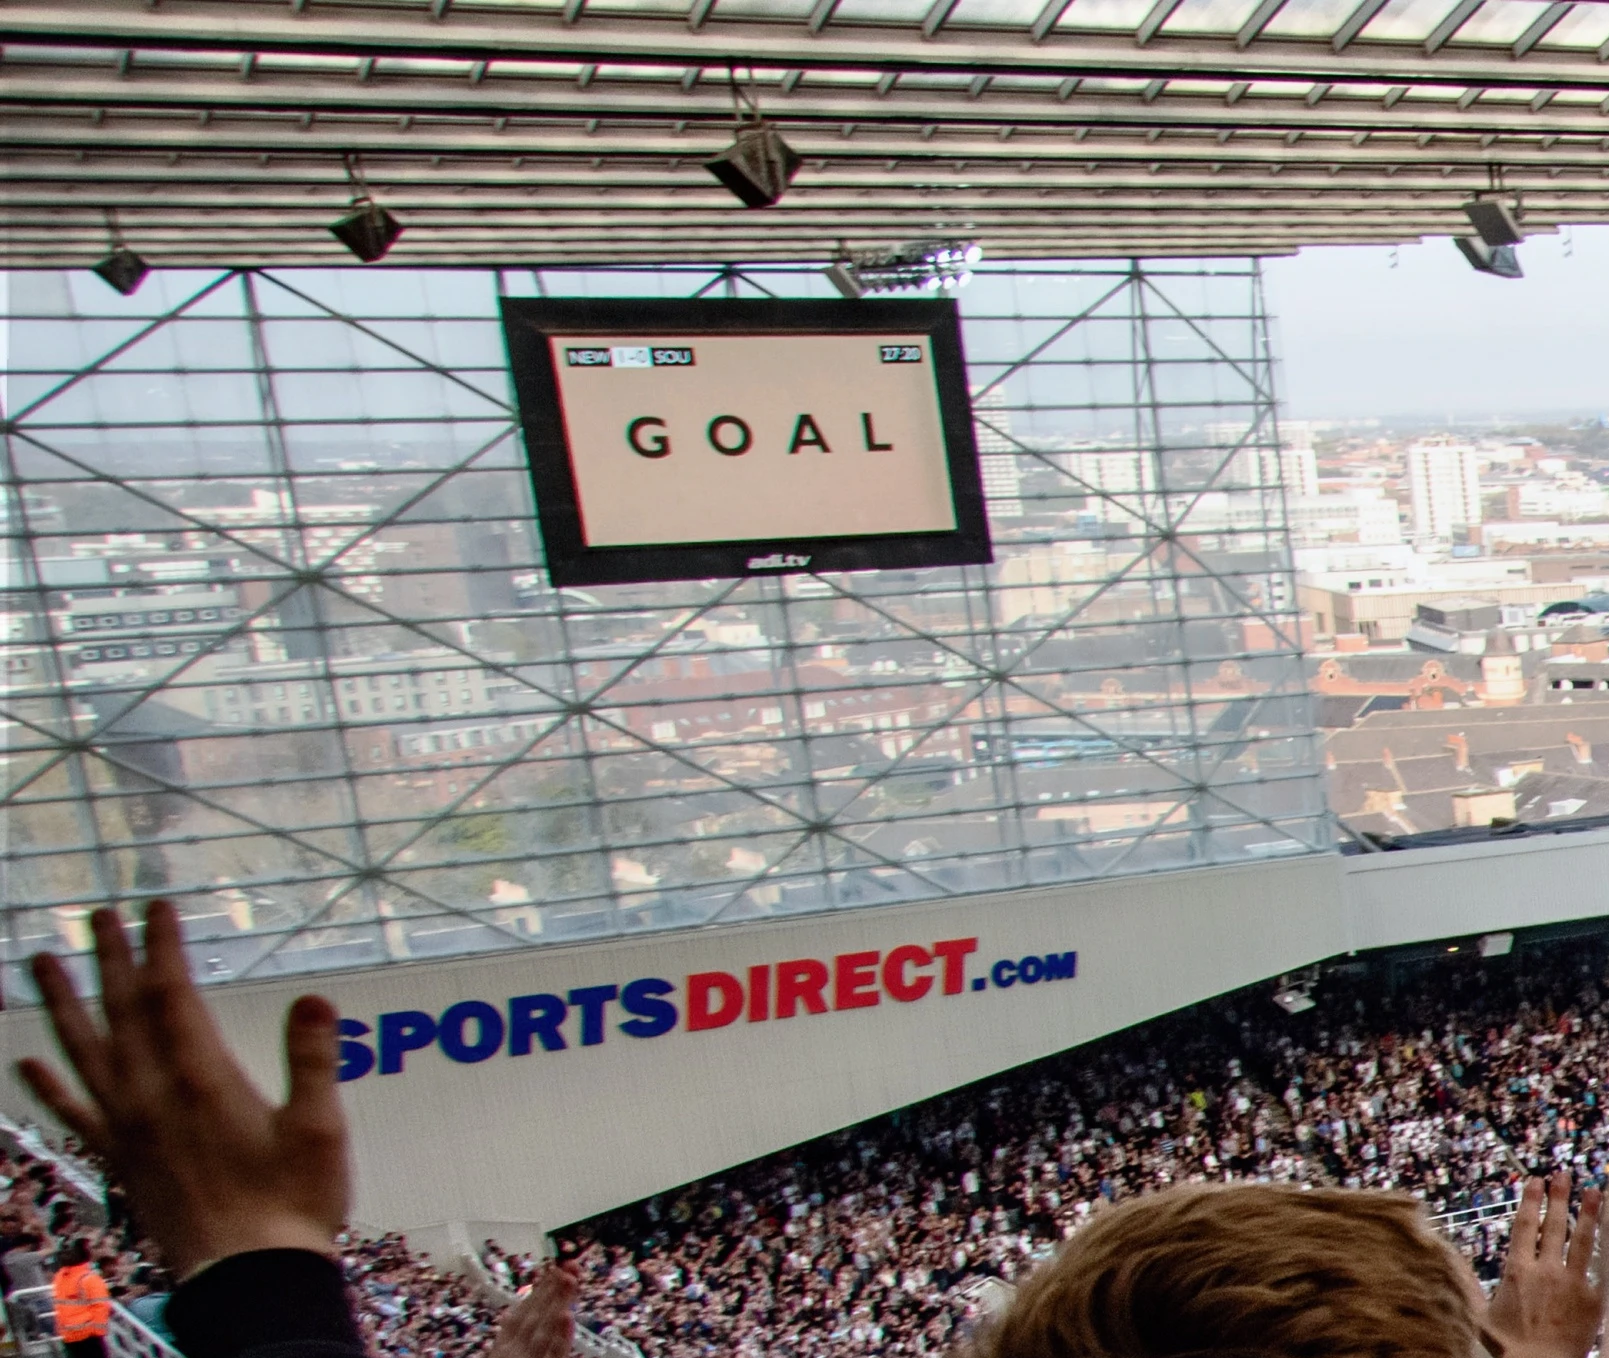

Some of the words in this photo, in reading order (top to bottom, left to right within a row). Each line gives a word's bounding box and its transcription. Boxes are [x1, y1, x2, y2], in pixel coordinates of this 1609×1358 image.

[568, 350, 611, 364] NEW
[654, 350, 692, 364] SOU
[625, 412, 893, 459] GOAL
